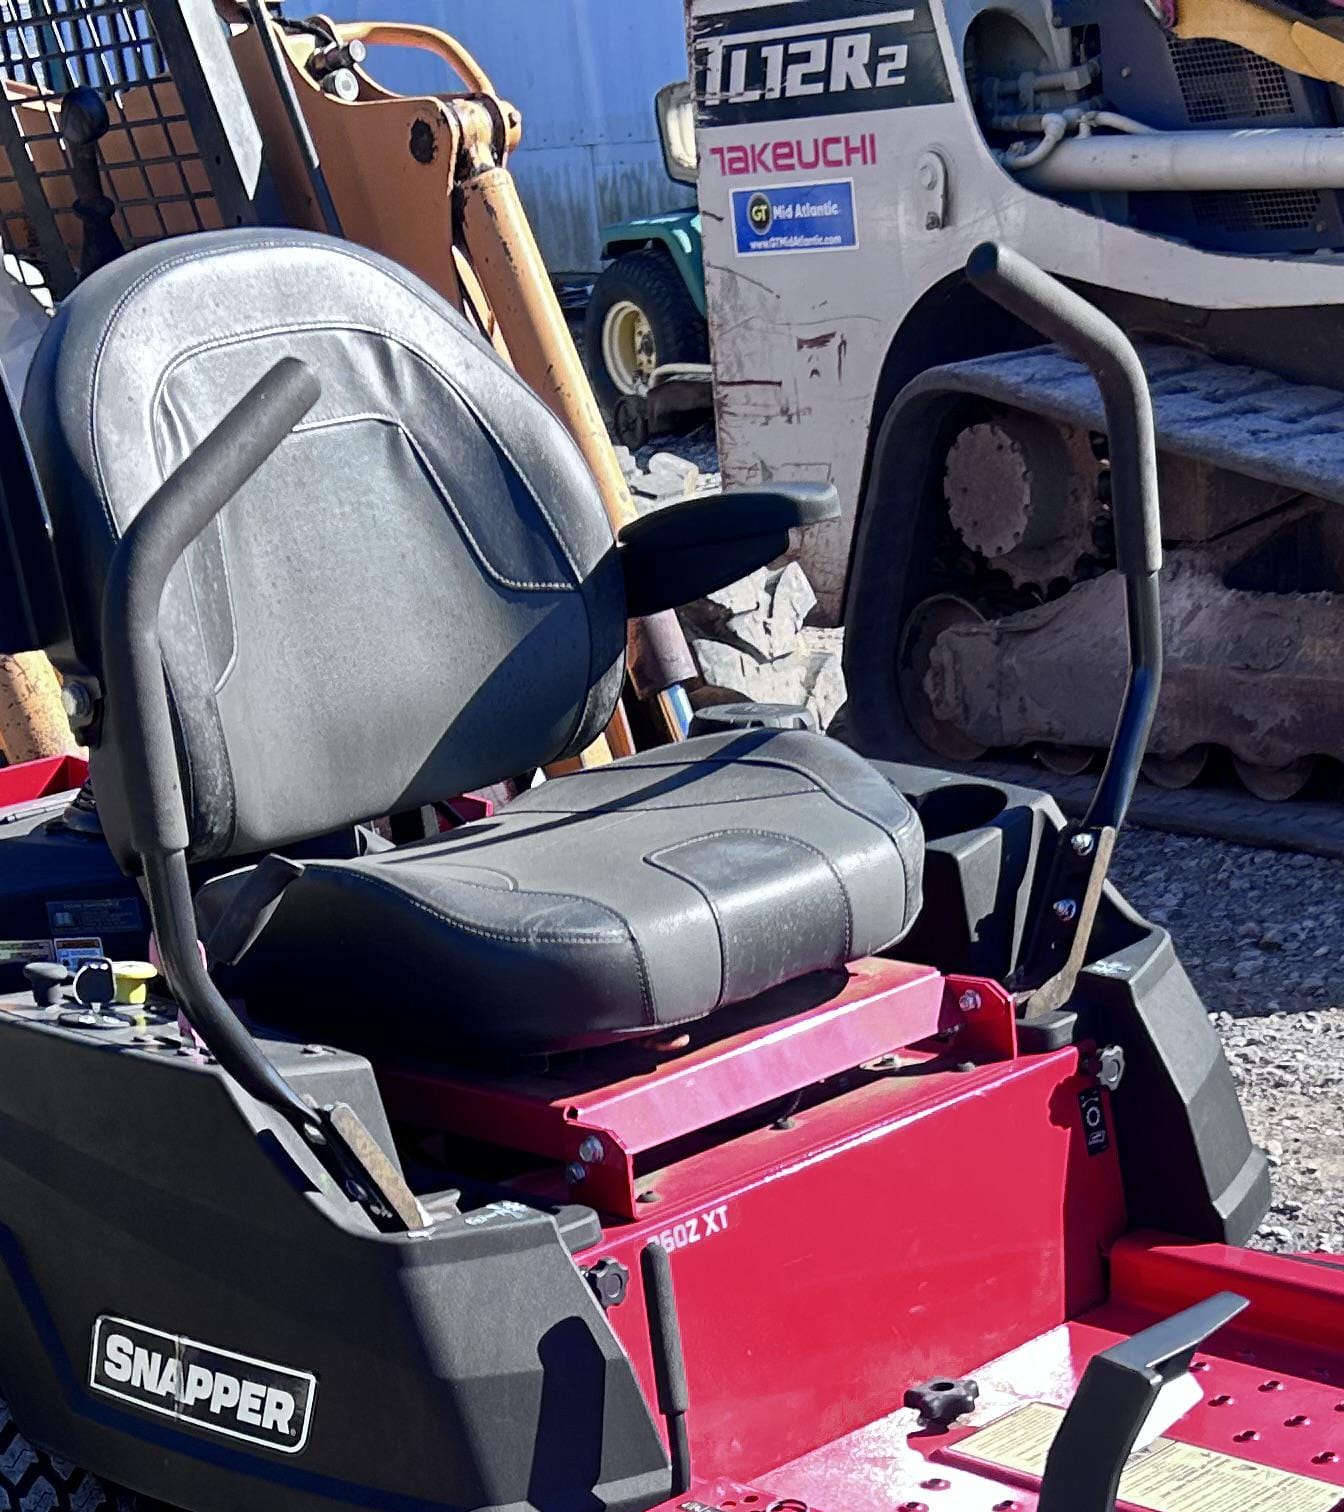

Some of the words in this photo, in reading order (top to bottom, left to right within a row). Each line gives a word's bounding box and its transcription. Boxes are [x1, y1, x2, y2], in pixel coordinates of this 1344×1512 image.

[751, 206, 768, 222] GT
[772, 205, 793, 220] Mid
[795, 200, 840, 218] Atlantic
[702, 1205, 729, 1236] XT
[103, 1333, 297, 1437] SNAPPER
